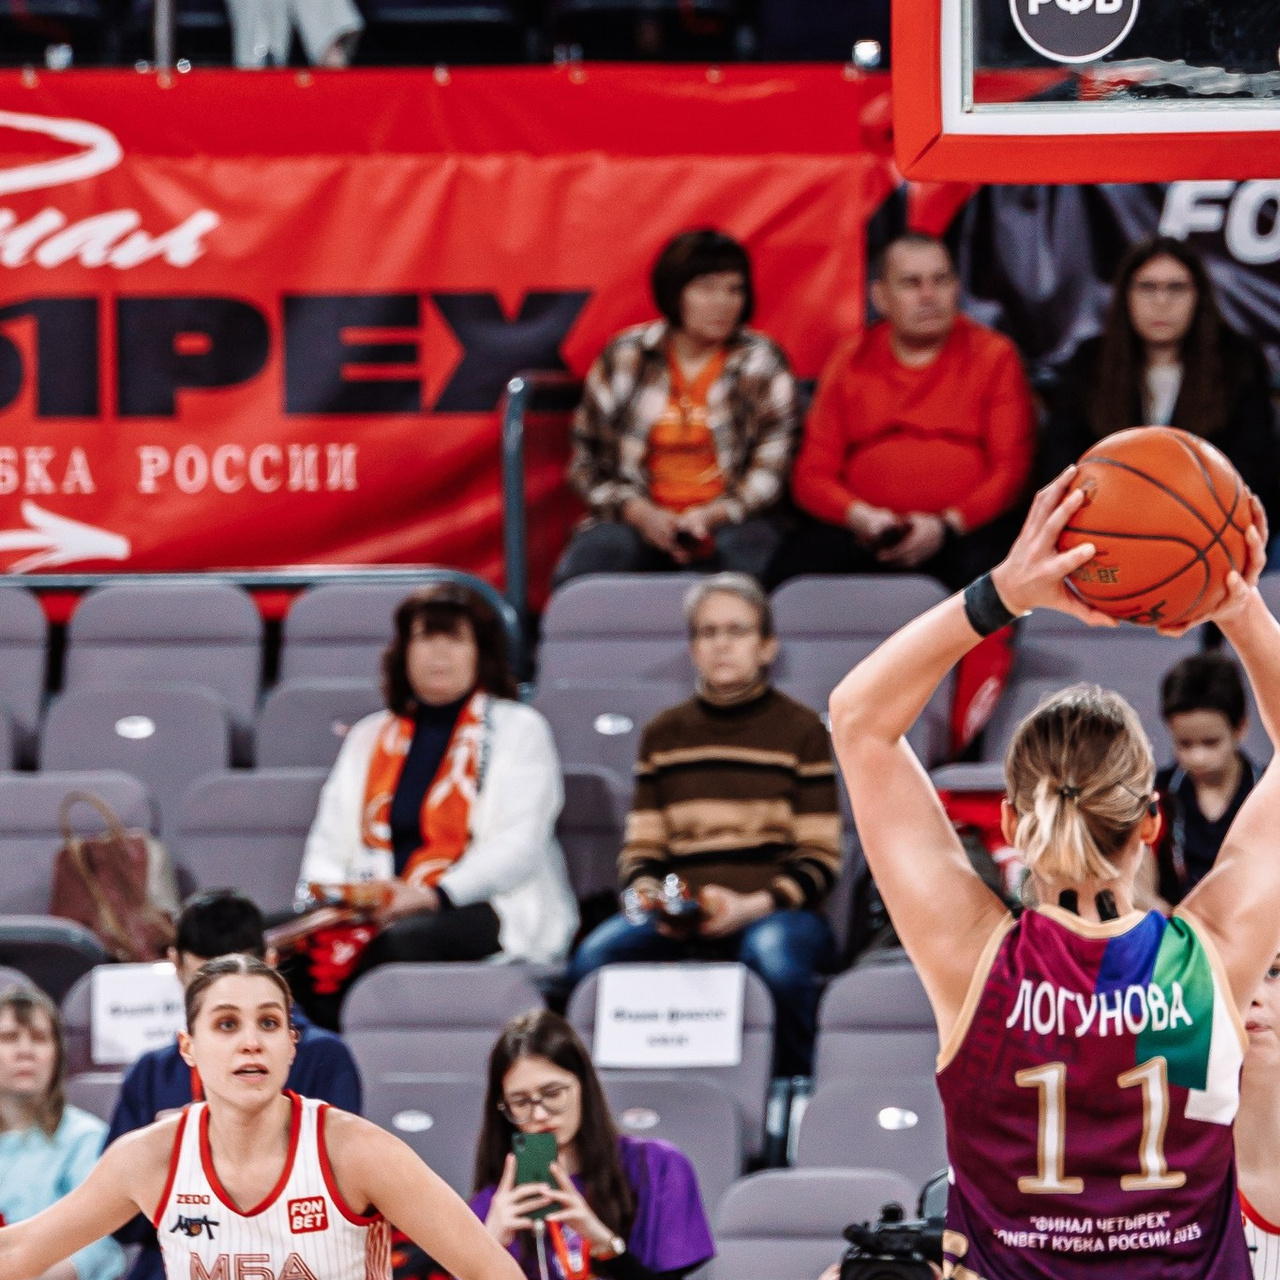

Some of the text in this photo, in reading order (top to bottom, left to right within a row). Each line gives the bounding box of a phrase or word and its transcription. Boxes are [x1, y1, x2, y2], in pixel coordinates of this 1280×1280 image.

[138, 442, 360, 494] РОССИИ
[1006, 978, 1193, 1037] ЛОГУНОВА
[1014, 1056, 1187, 1195] 11
[290, 1200, 324, 1216] FON
[292, 1214, 325, 1230] BET
[1052, 1234, 1105, 1252] КУБКА
[1108, 1229, 1171, 1251] РОССИИ
